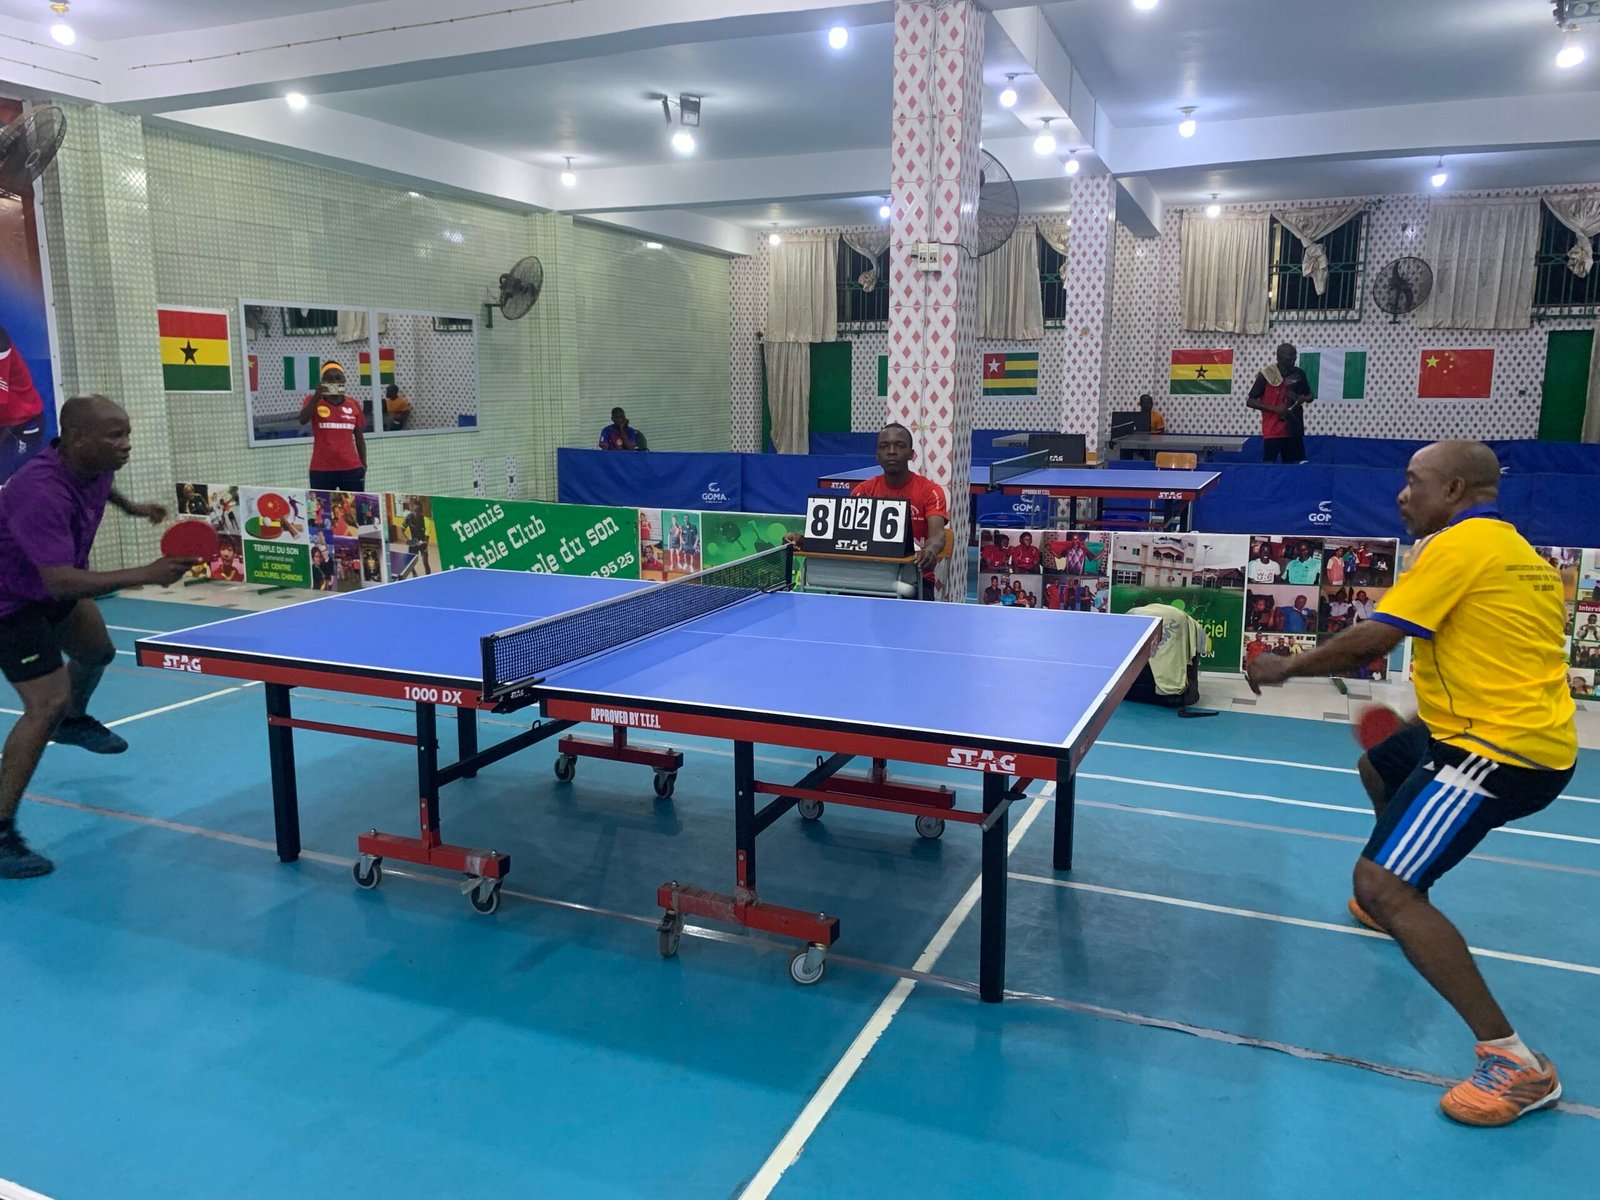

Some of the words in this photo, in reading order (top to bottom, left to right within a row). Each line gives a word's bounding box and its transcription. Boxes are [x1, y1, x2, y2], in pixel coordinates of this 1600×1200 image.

[1158, 491, 1182, 499] STAG
[451, 503, 505, 543] Tennis
[811, 504, 830, 537] 8
[880, 507, 900, 540] 6
[254, 544, 275, 553] TEMPLE
[277, 546, 285, 554] DU
[286, 547, 299, 555] SON
[464, 540, 509, 569] Table
[507, 515, 546, 550] Club
[526, 552, 560, 574] ple
[559, 537, 586, 563] du
[586, 516, 620, 547] son
[835, 540, 868, 551] STAG
[600, 561, 618, 578] 95
[617, 551, 635, 569] 25
[1196, 620, 1227, 638] ciel
[163, 654, 201, 672] STAG
[403, 686, 438, 703] 1000
[441, 688, 463, 704] DX
[590, 707, 628, 725] APPROVED
[629, 713, 639, 726] BY
[947, 748, 1015, 773] STAG
